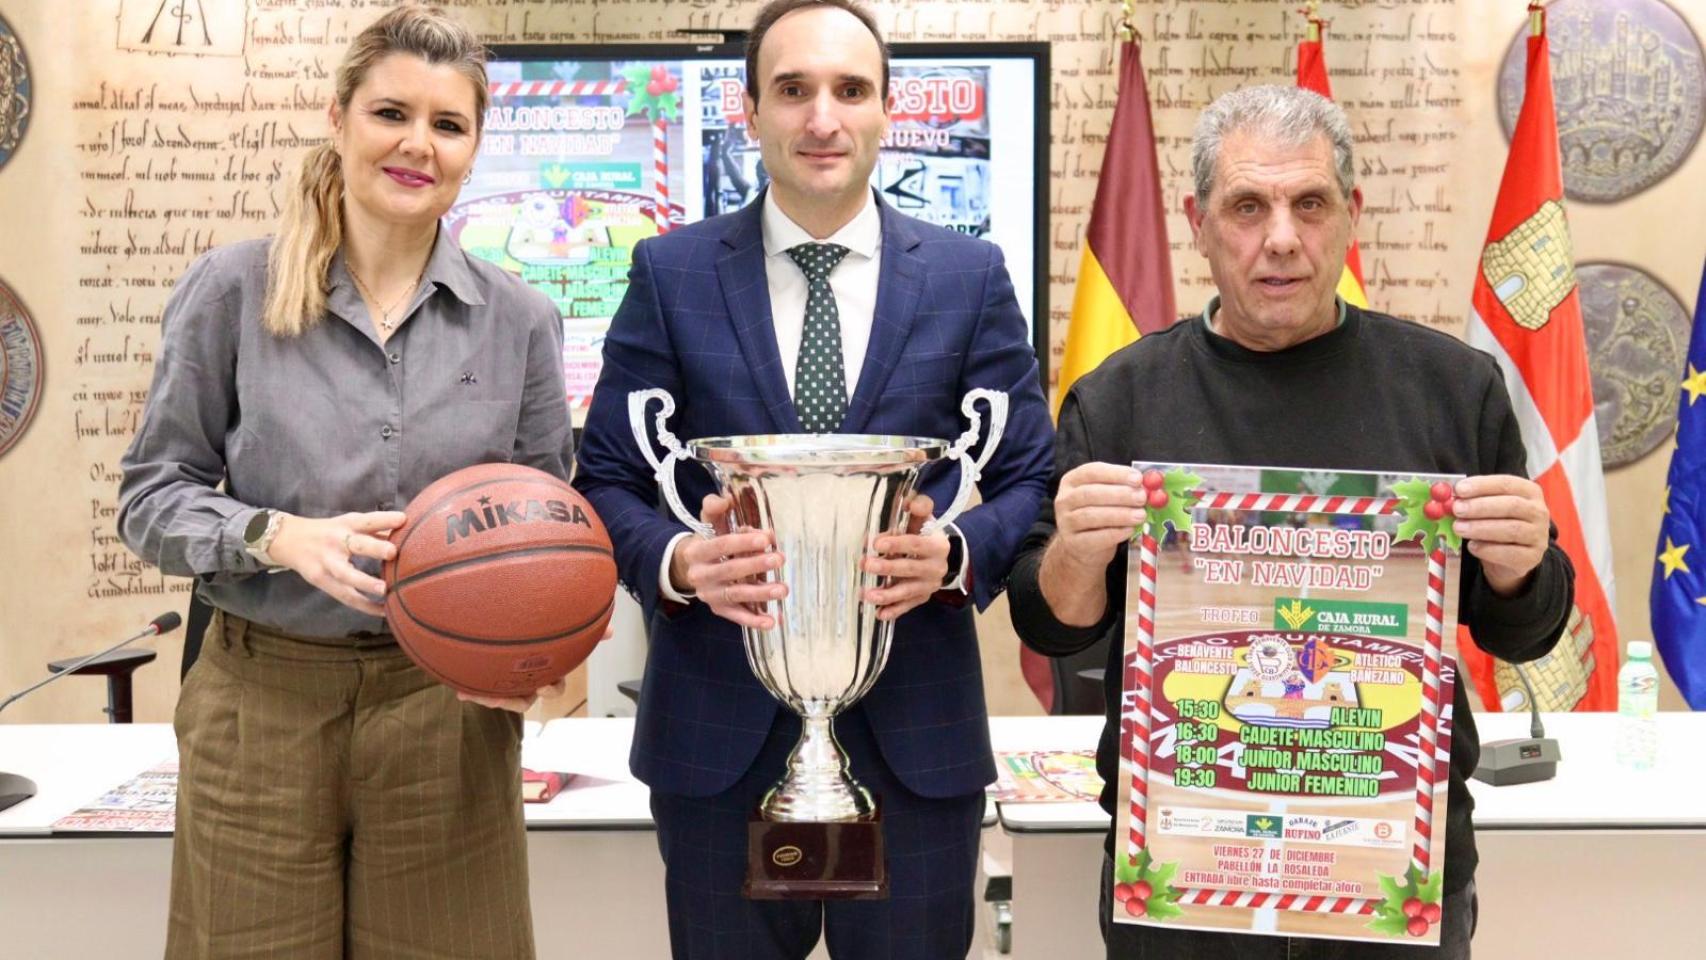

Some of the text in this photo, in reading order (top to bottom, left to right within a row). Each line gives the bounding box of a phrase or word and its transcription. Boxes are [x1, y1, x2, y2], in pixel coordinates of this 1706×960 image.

[484, 106, 625, 131] ALONCESTO
[1192, 524, 1390, 559] BALONCESTO
[1194, 559, 1383, 590] "EN NAVIDAD"
[1201, 607, 1259, 624] TROFEO
[1317, 611, 1399, 627] CAJA RURAL
[1318, 624, 1371, 634] DE ZAMORA
[1177, 643, 1234, 659] BENAVENTE
[1354, 654, 1402, 668] ATLETICO
[1174, 658, 1238, 675] BALONCESTO
[1176, 699, 1220, 719] 15:30
[1330, 706, 1382, 728] ALEVIN
[1175, 721, 1219, 742] 16:30
[1239, 725, 1386, 752] CADETE MASCULINO
[1174, 745, 1217, 765] 18:00
[1239, 748, 1382, 775] JUNIOR MASCULINO
[1173, 768, 1216, 788] 19:30
[1247, 771, 1380, 798] JUNIOR FEMENINO
[1284, 828, 1321, 841] RUFINO
[1213, 846, 1336, 863] VIERNES 27 DE DICIEMBRE
[1217, 859, 1330, 877] PABELLÓN LA ROSALEDA
[1184, 871, 1362, 894] ENTRADA libre hasta completar aforo
